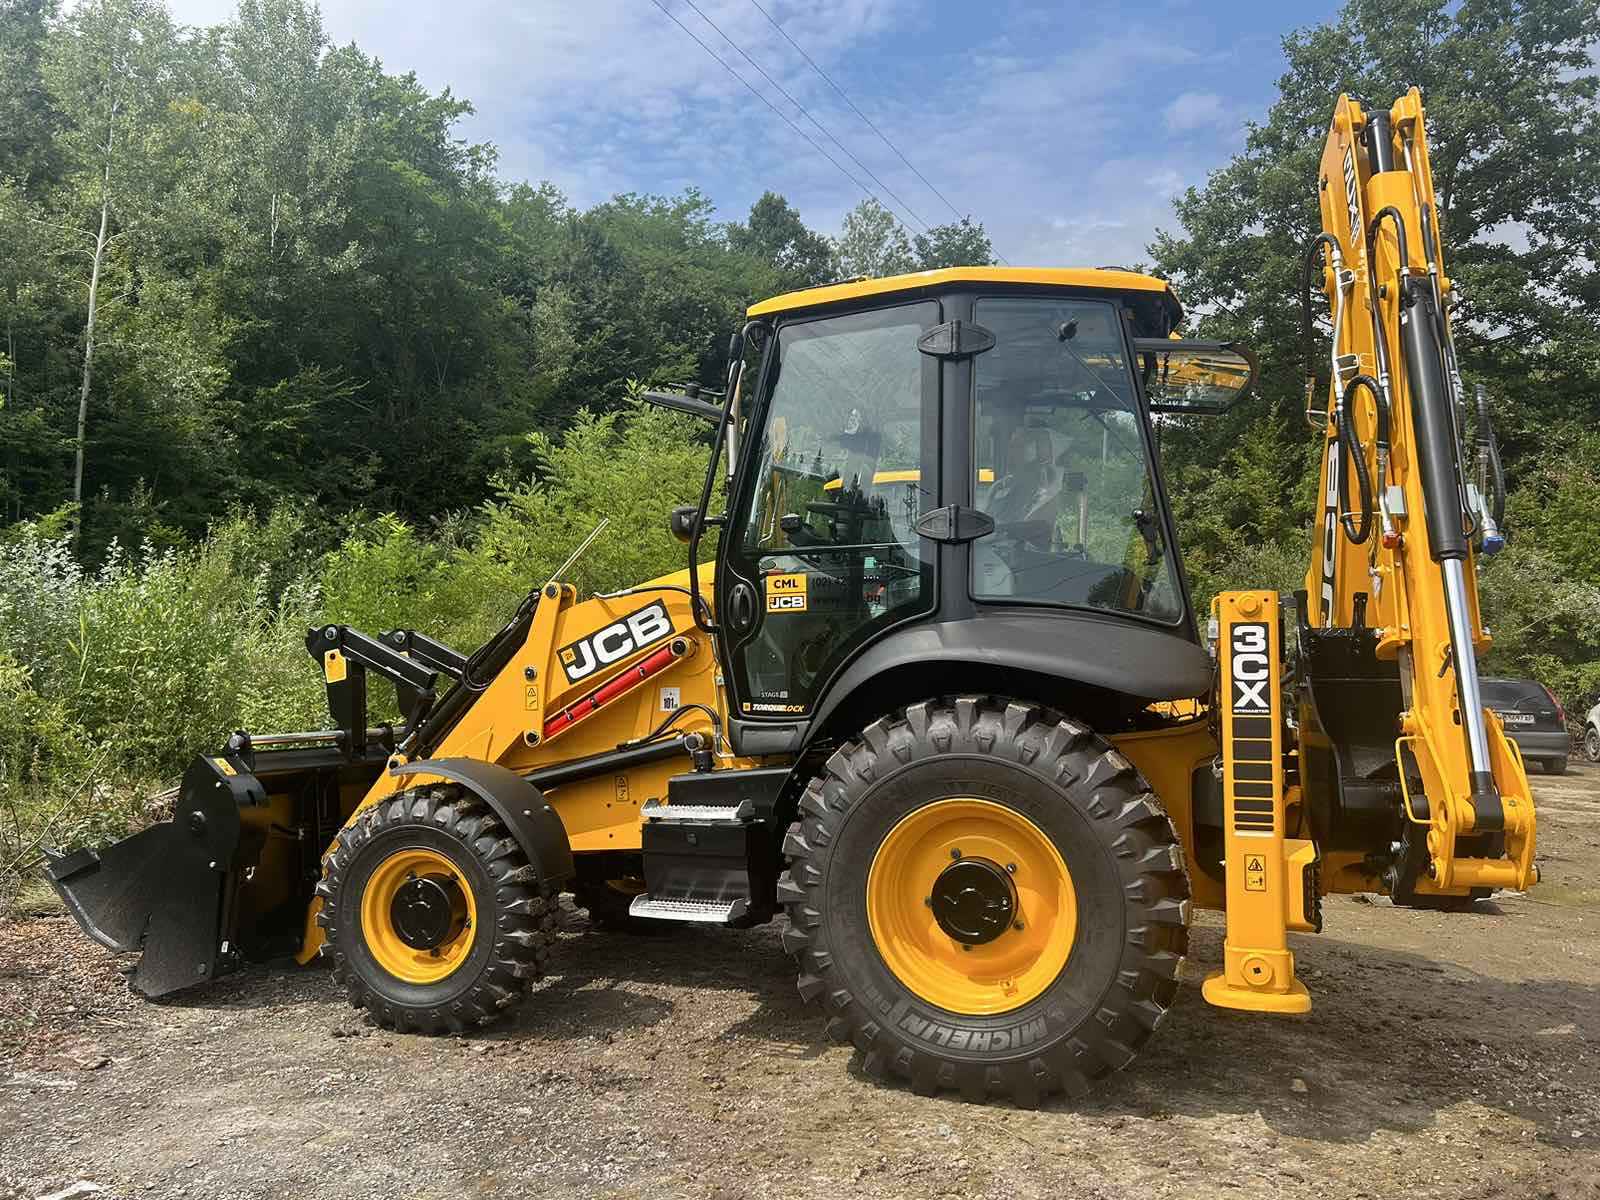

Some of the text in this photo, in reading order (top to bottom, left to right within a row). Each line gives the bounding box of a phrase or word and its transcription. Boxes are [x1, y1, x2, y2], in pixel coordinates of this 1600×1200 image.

[774, 579, 798, 589] CML
[769, 596, 804, 608] JCB
[566, 604, 670, 680] JCB
[1232, 625, 1269, 707] 3CX
[752, 703, 804, 713] TORQUELOCK
[899, 1012, 1047, 1051] MICHELIN
